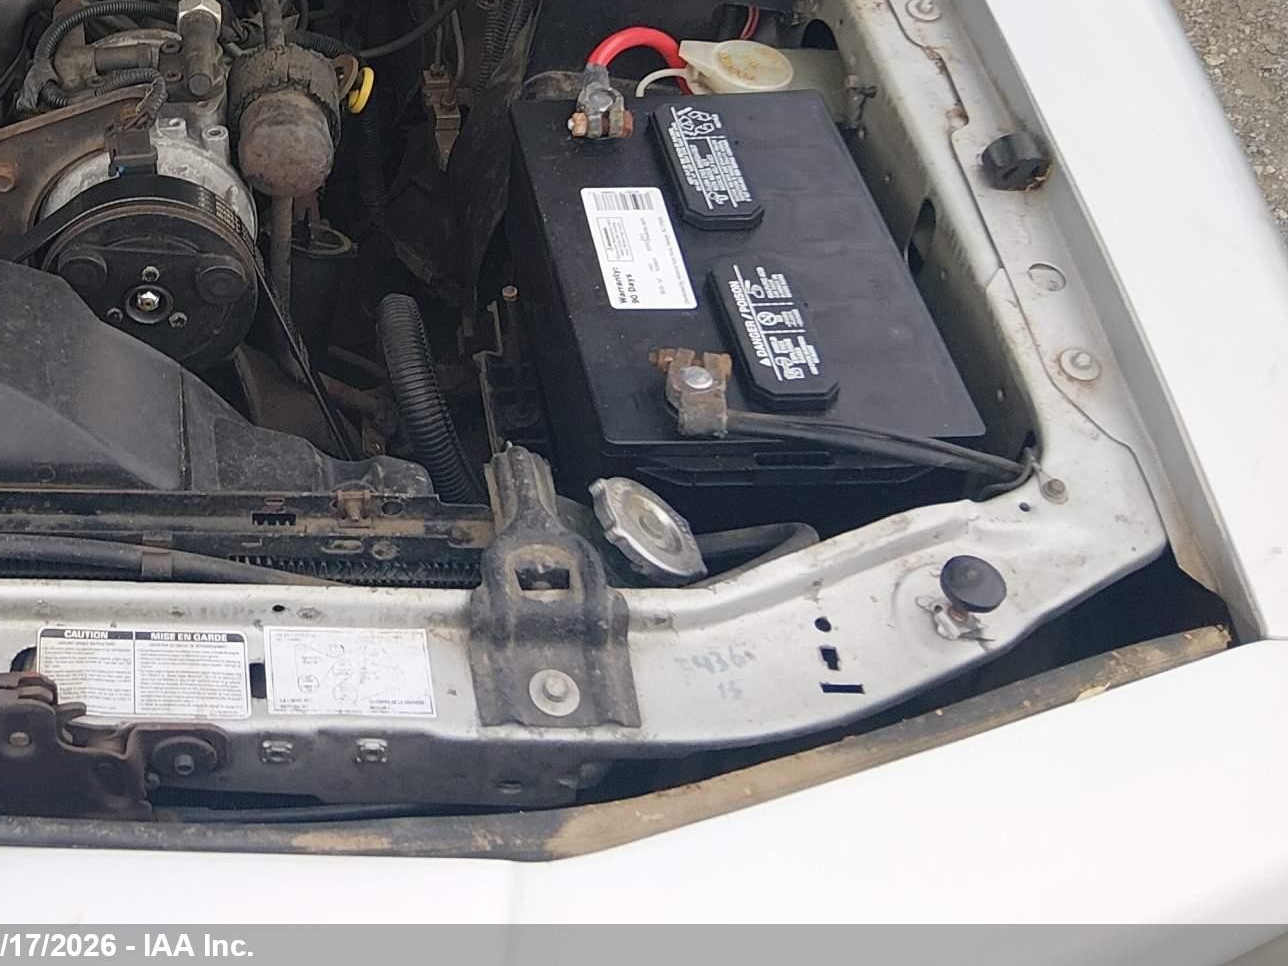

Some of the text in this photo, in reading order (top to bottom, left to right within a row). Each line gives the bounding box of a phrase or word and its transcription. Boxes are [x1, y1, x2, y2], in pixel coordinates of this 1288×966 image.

[626, 274, 636, 293] Days
[728, 280, 751, 313] POISON
[744, 320, 768, 358] DANGER
[64, 630, 109, 639] CAUTION
[150, 632, 228, 642] MISE EN GARDE
